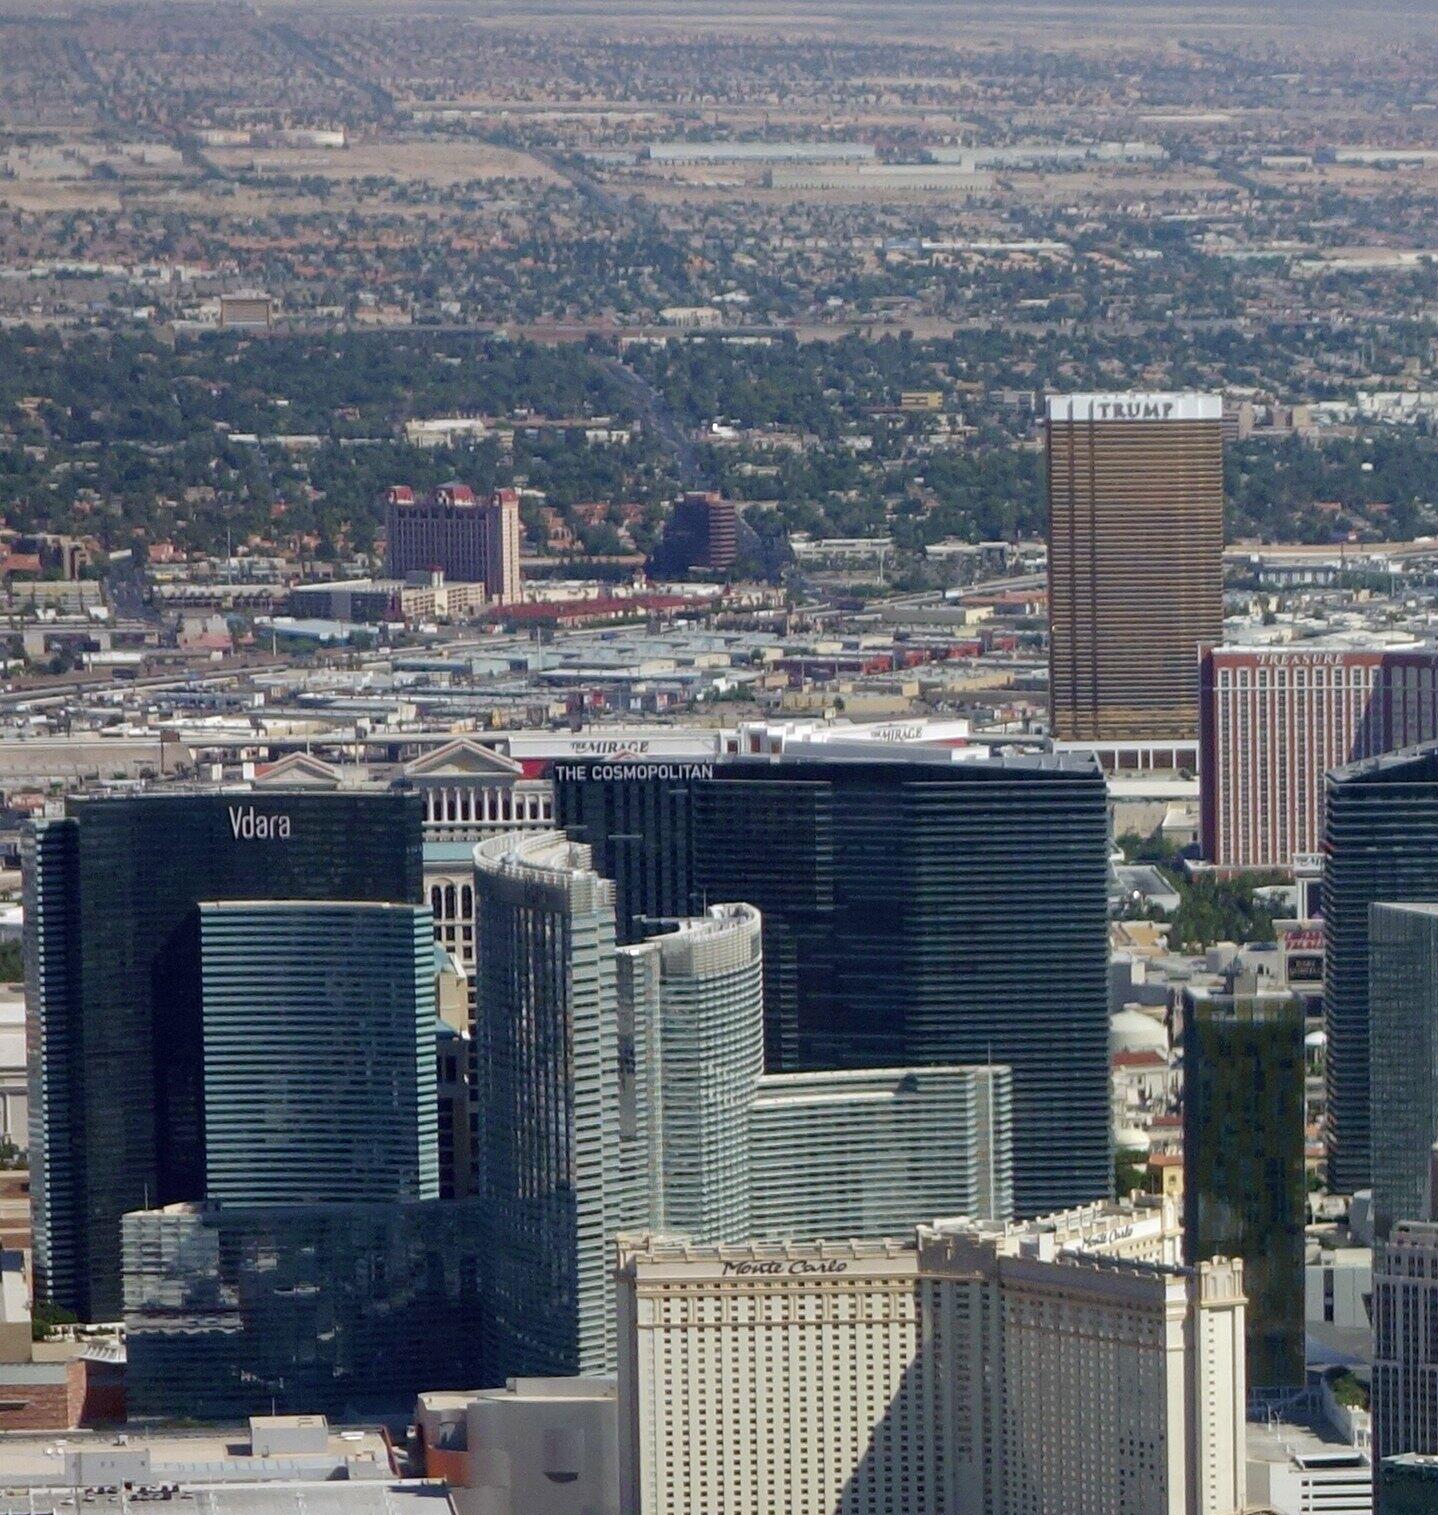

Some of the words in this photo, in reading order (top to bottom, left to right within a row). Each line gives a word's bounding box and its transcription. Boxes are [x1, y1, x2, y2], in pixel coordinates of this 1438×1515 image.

[1100, 402, 1173, 418] TRUMP
[1256, 653, 1344, 665] TREASURE
[880, 727, 923, 742] MIRAGE
[588, 741, 649, 754] MIRAGE
[555, 766, 586, 781] THE
[591, 765, 714, 781] COSMOPOLITAN
[228, 806, 291, 840] Vdara
[722, 1260, 783, 1275] Monte
[788, 1259, 848, 1275] Carlo
